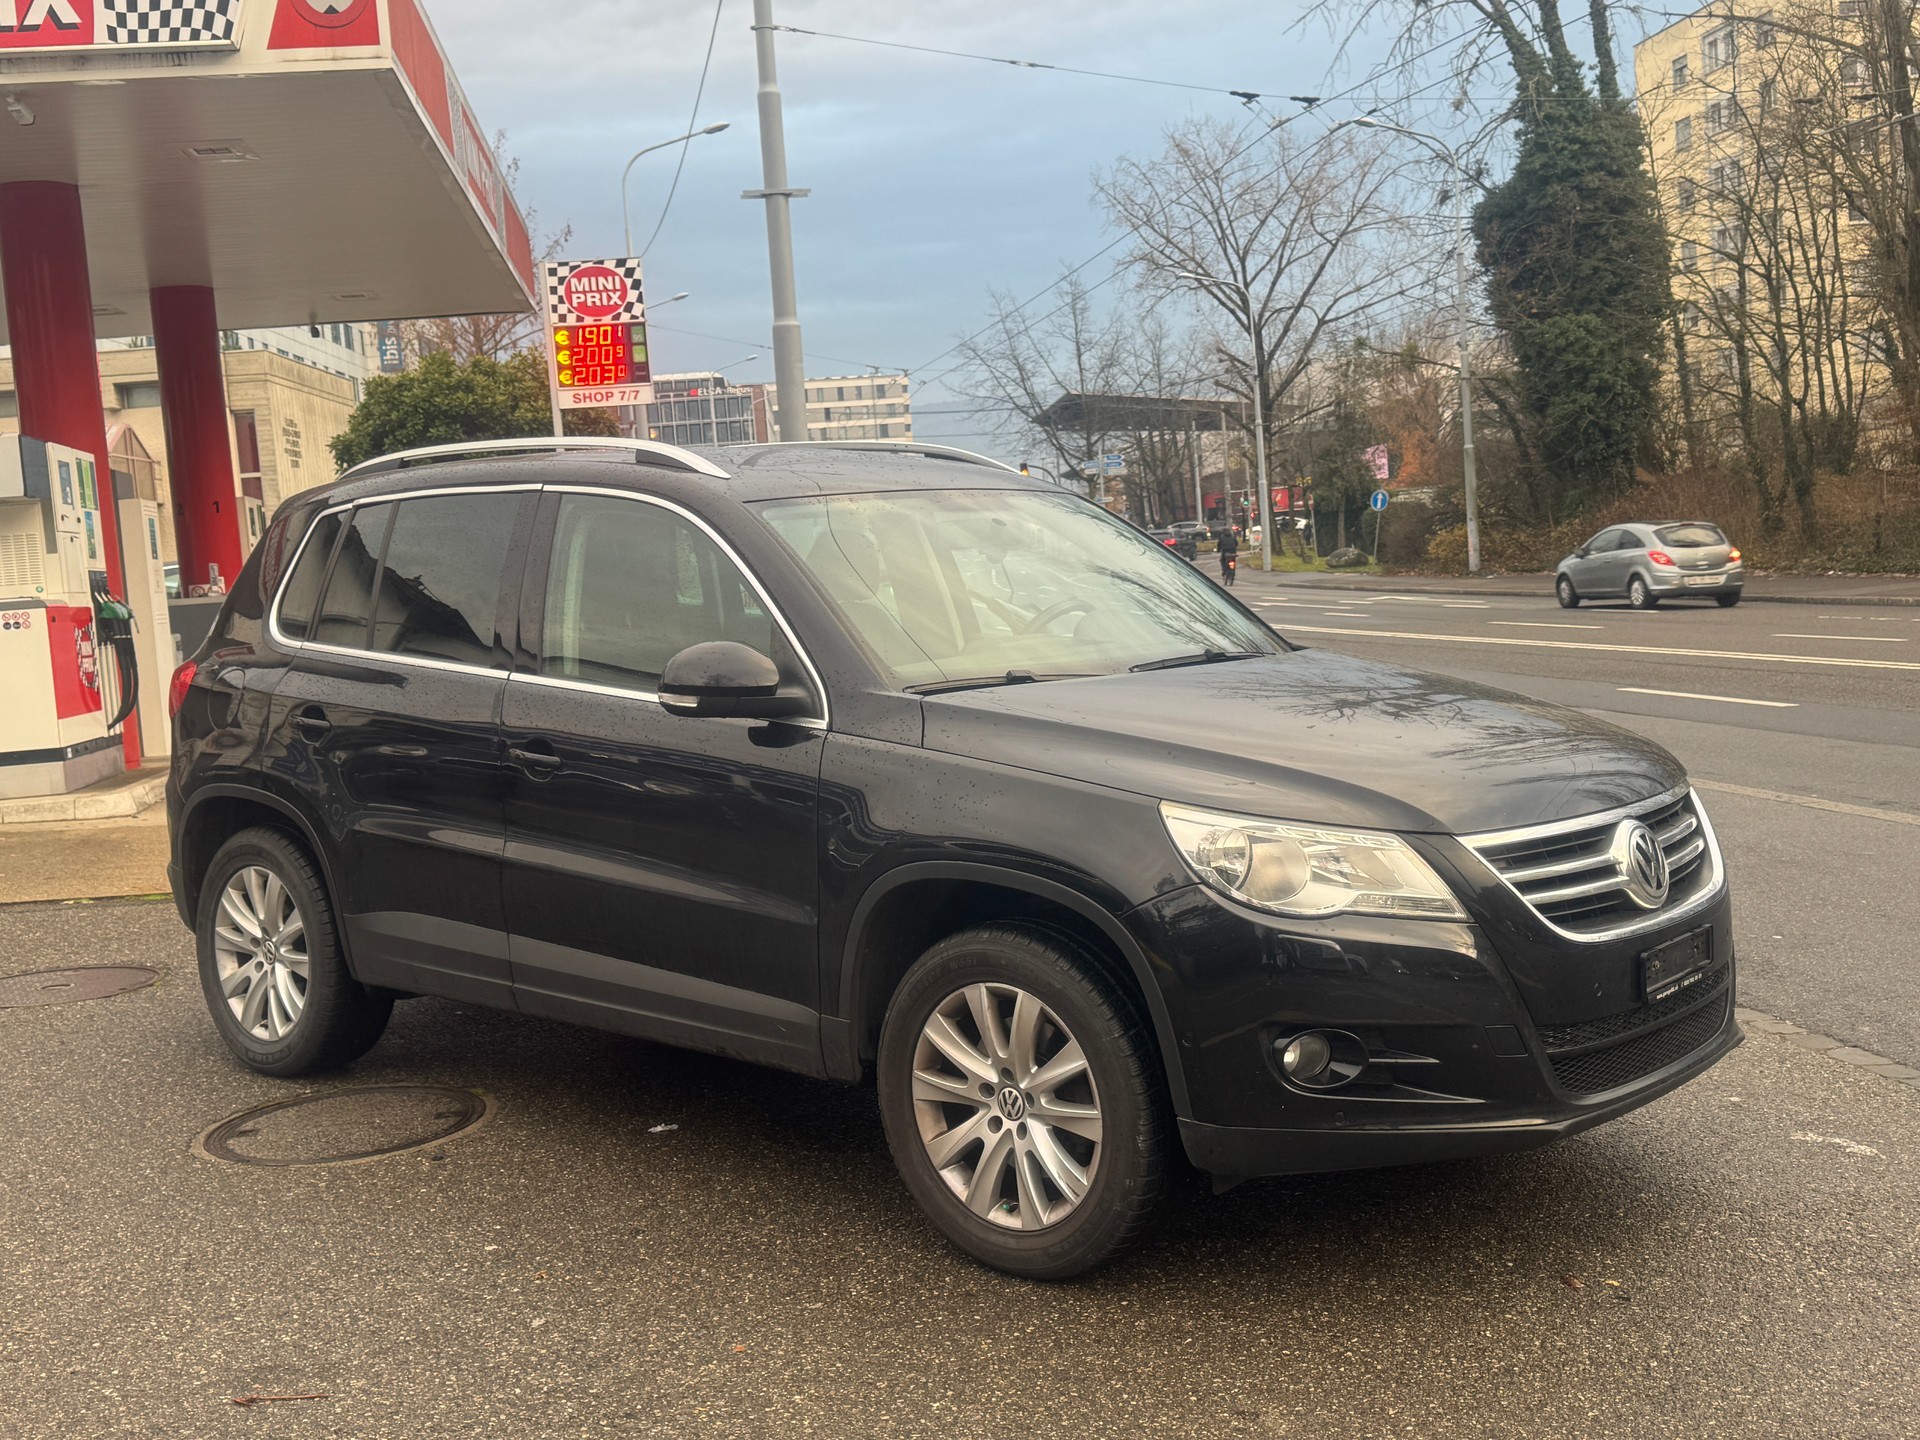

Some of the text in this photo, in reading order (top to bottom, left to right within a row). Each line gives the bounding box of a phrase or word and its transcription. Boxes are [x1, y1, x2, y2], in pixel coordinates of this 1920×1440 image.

[570, 275, 622, 292] MINI
[571, 291, 623, 308] PRIX
[554, 330, 569, 345] €
[382, 336, 399, 365] ibis
[557, 350, 571, 365] €
[559, 370, 573, 385] €
[572, 390, 640, 404] SHOP 7/7
[698, 386, 722, 396] ELSA
[212, 501, 220, 513] 1
